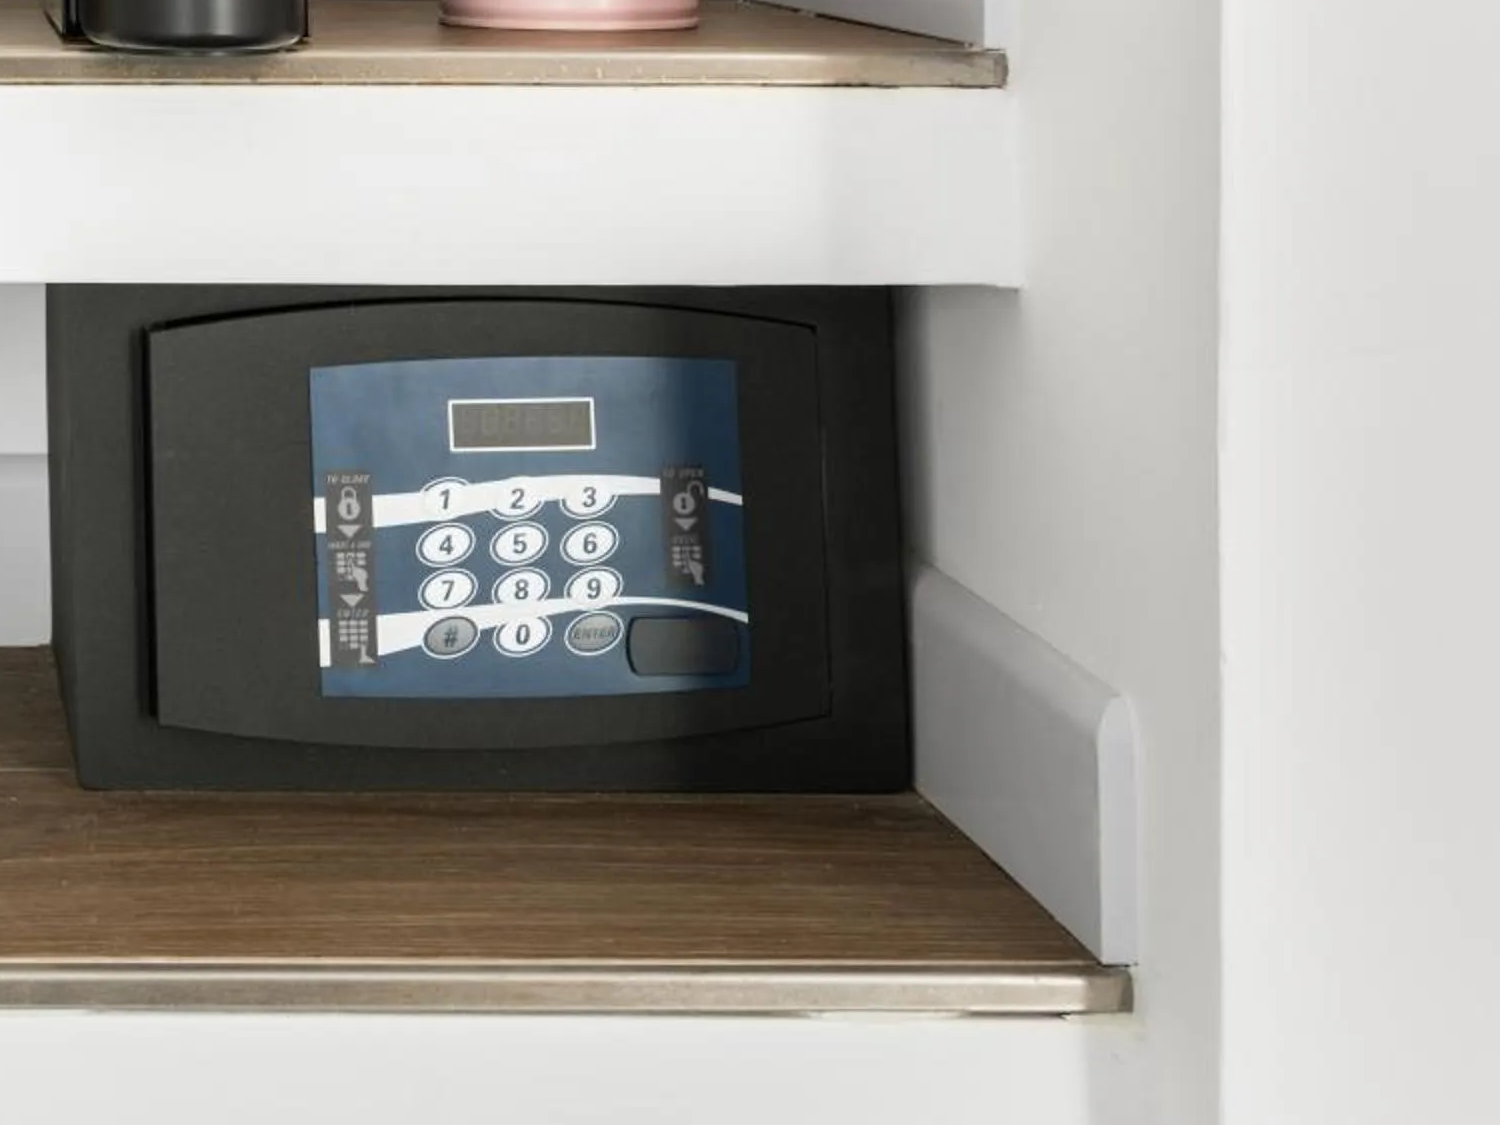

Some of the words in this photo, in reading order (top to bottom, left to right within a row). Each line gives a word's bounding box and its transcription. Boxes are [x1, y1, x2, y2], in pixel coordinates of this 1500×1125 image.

[439, 488, 450, 510] 1
[510, 488, 525, 510] 2
[582, 486, 597, 508] 3
[439, 534, 455, 555] 4
[513, 532, 528, 554] 5
[583, 532, 597, 554] 6
[441, 579, 455, 601] 7
[514, 578, 529, 601] 8
[587, 578, 601, 600] 9
[515, 623, 531, 646] 0
